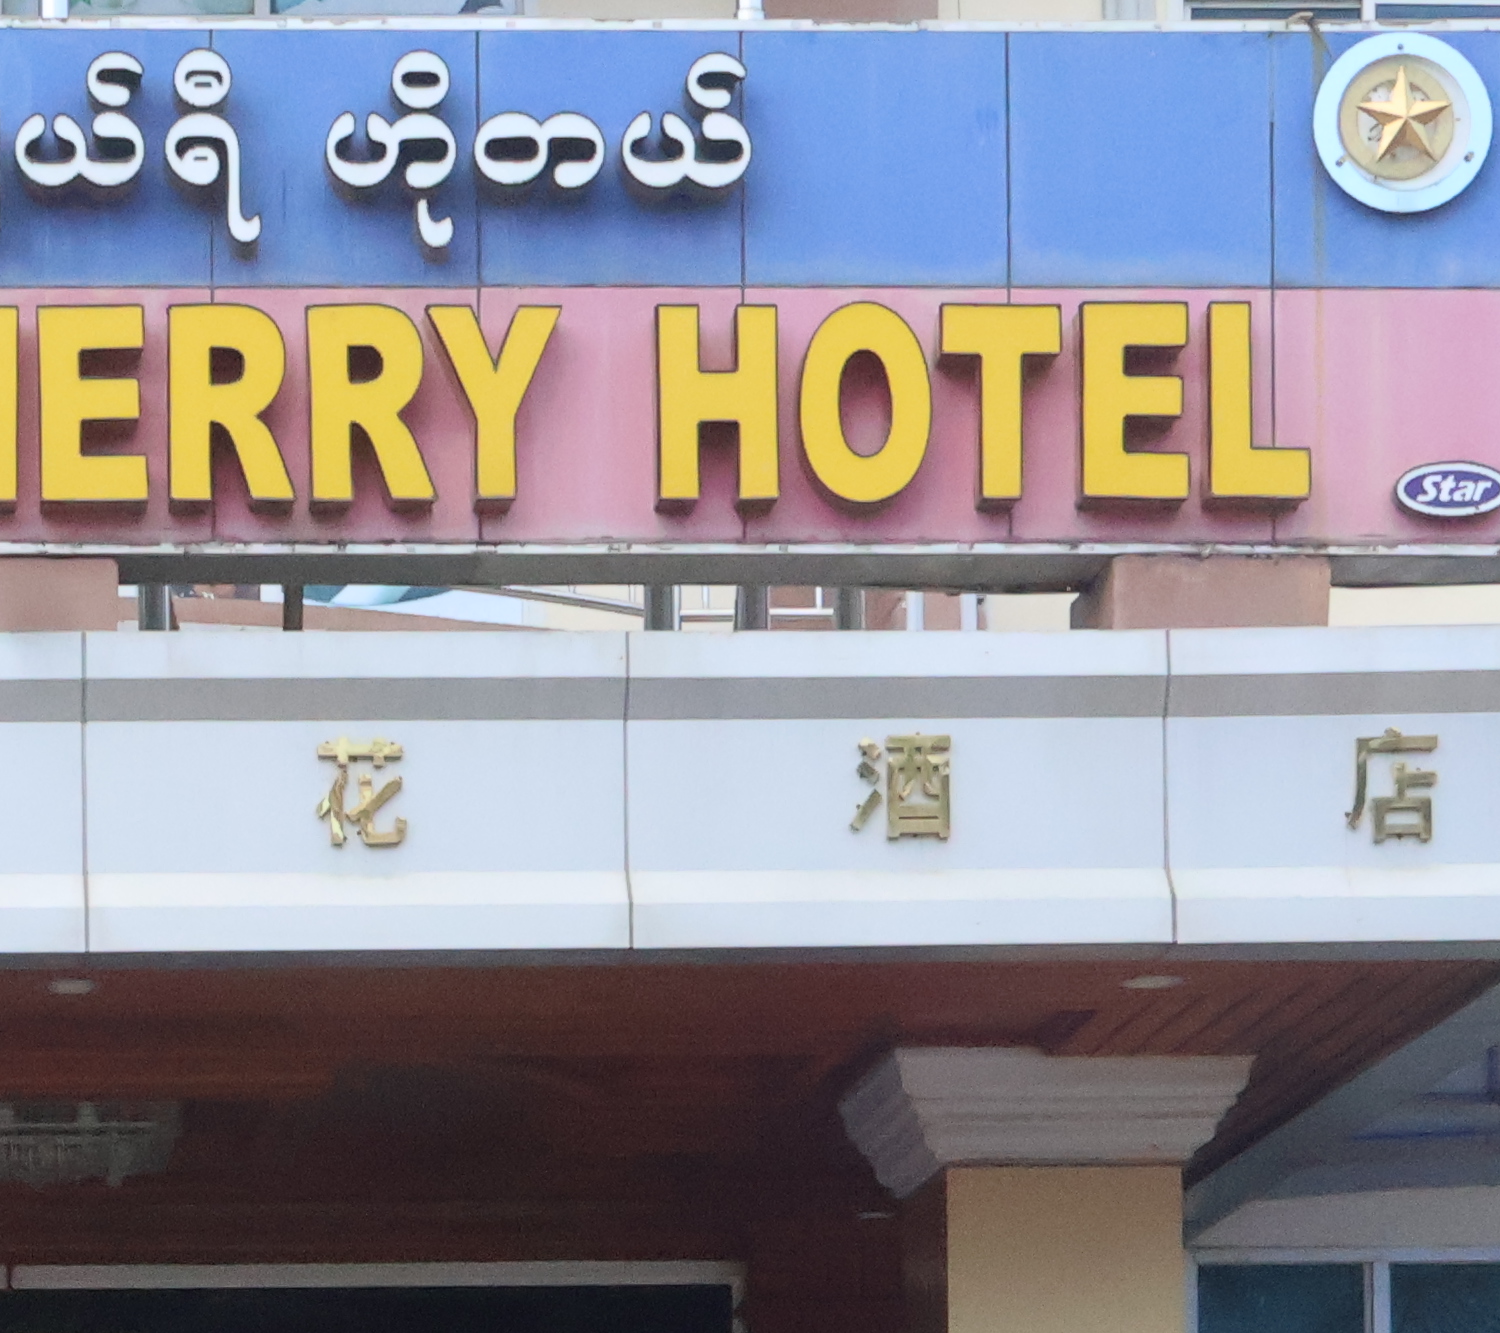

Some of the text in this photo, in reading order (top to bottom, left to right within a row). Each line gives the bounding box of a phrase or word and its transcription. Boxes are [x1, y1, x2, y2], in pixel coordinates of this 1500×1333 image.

[324, 49, 753, 248] ဟိုတယ်
[655, 301, 1312, 510] HOTEL
[1415, 473, 1493, 503] Star
